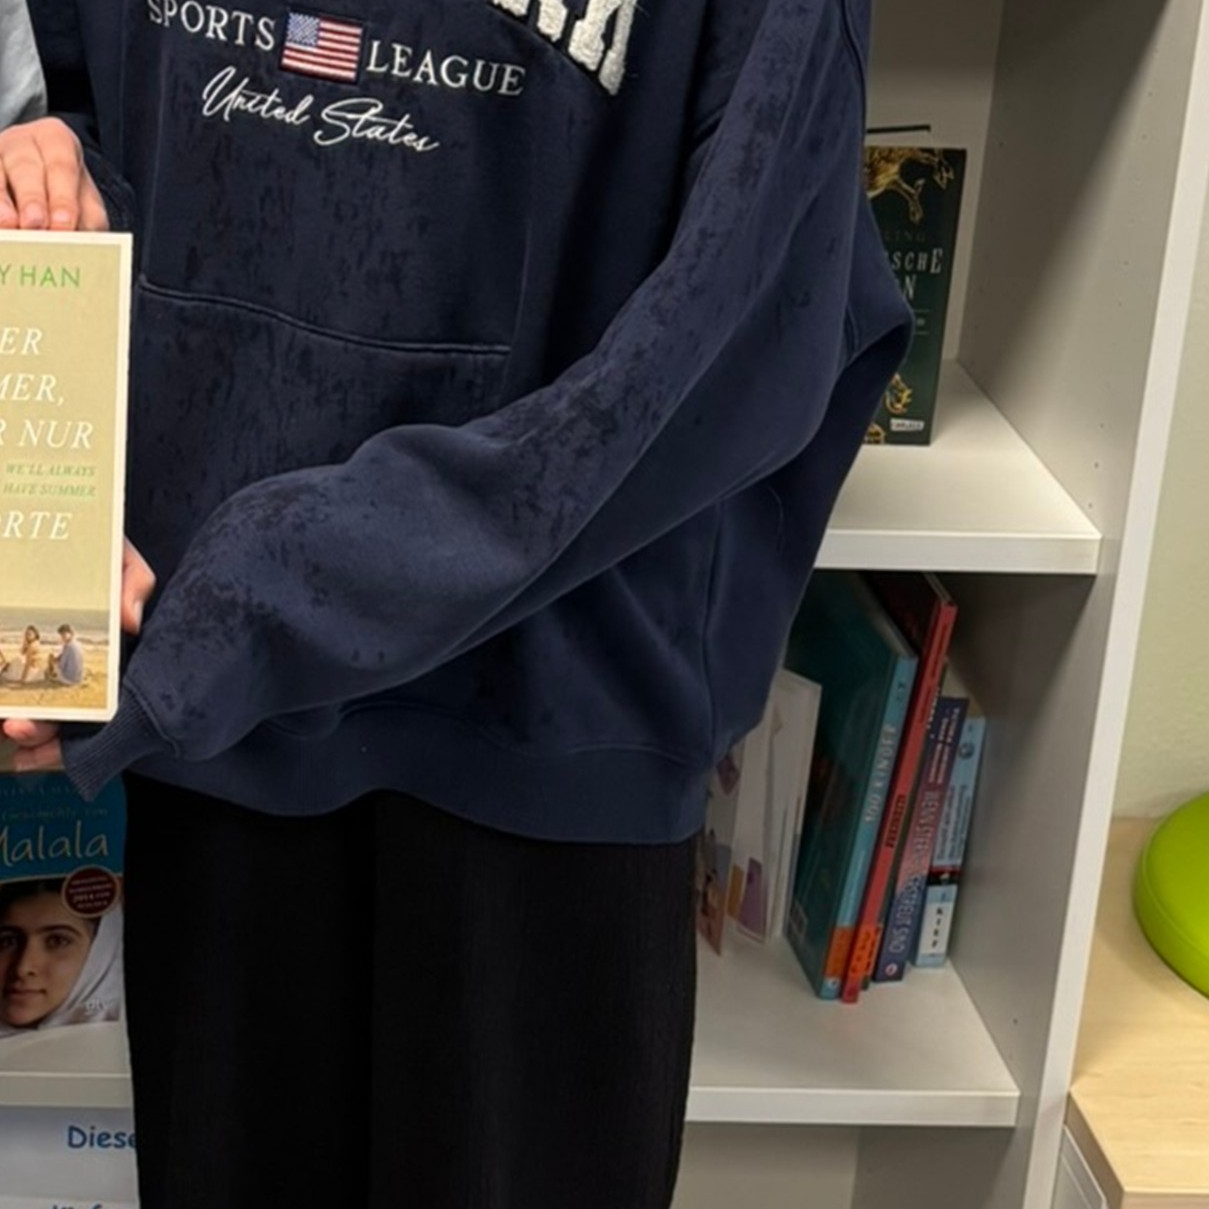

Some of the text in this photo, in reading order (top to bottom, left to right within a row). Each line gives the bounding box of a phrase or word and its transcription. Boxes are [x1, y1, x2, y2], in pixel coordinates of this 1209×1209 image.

[367, 40, 527, 97] LEAGUE
[201, 66, 442, 153] United States
[19, 265, 81, 288] HAN
[19, 418, 94, 450] NUR
[39, 483, 97, 497] SUMMER
